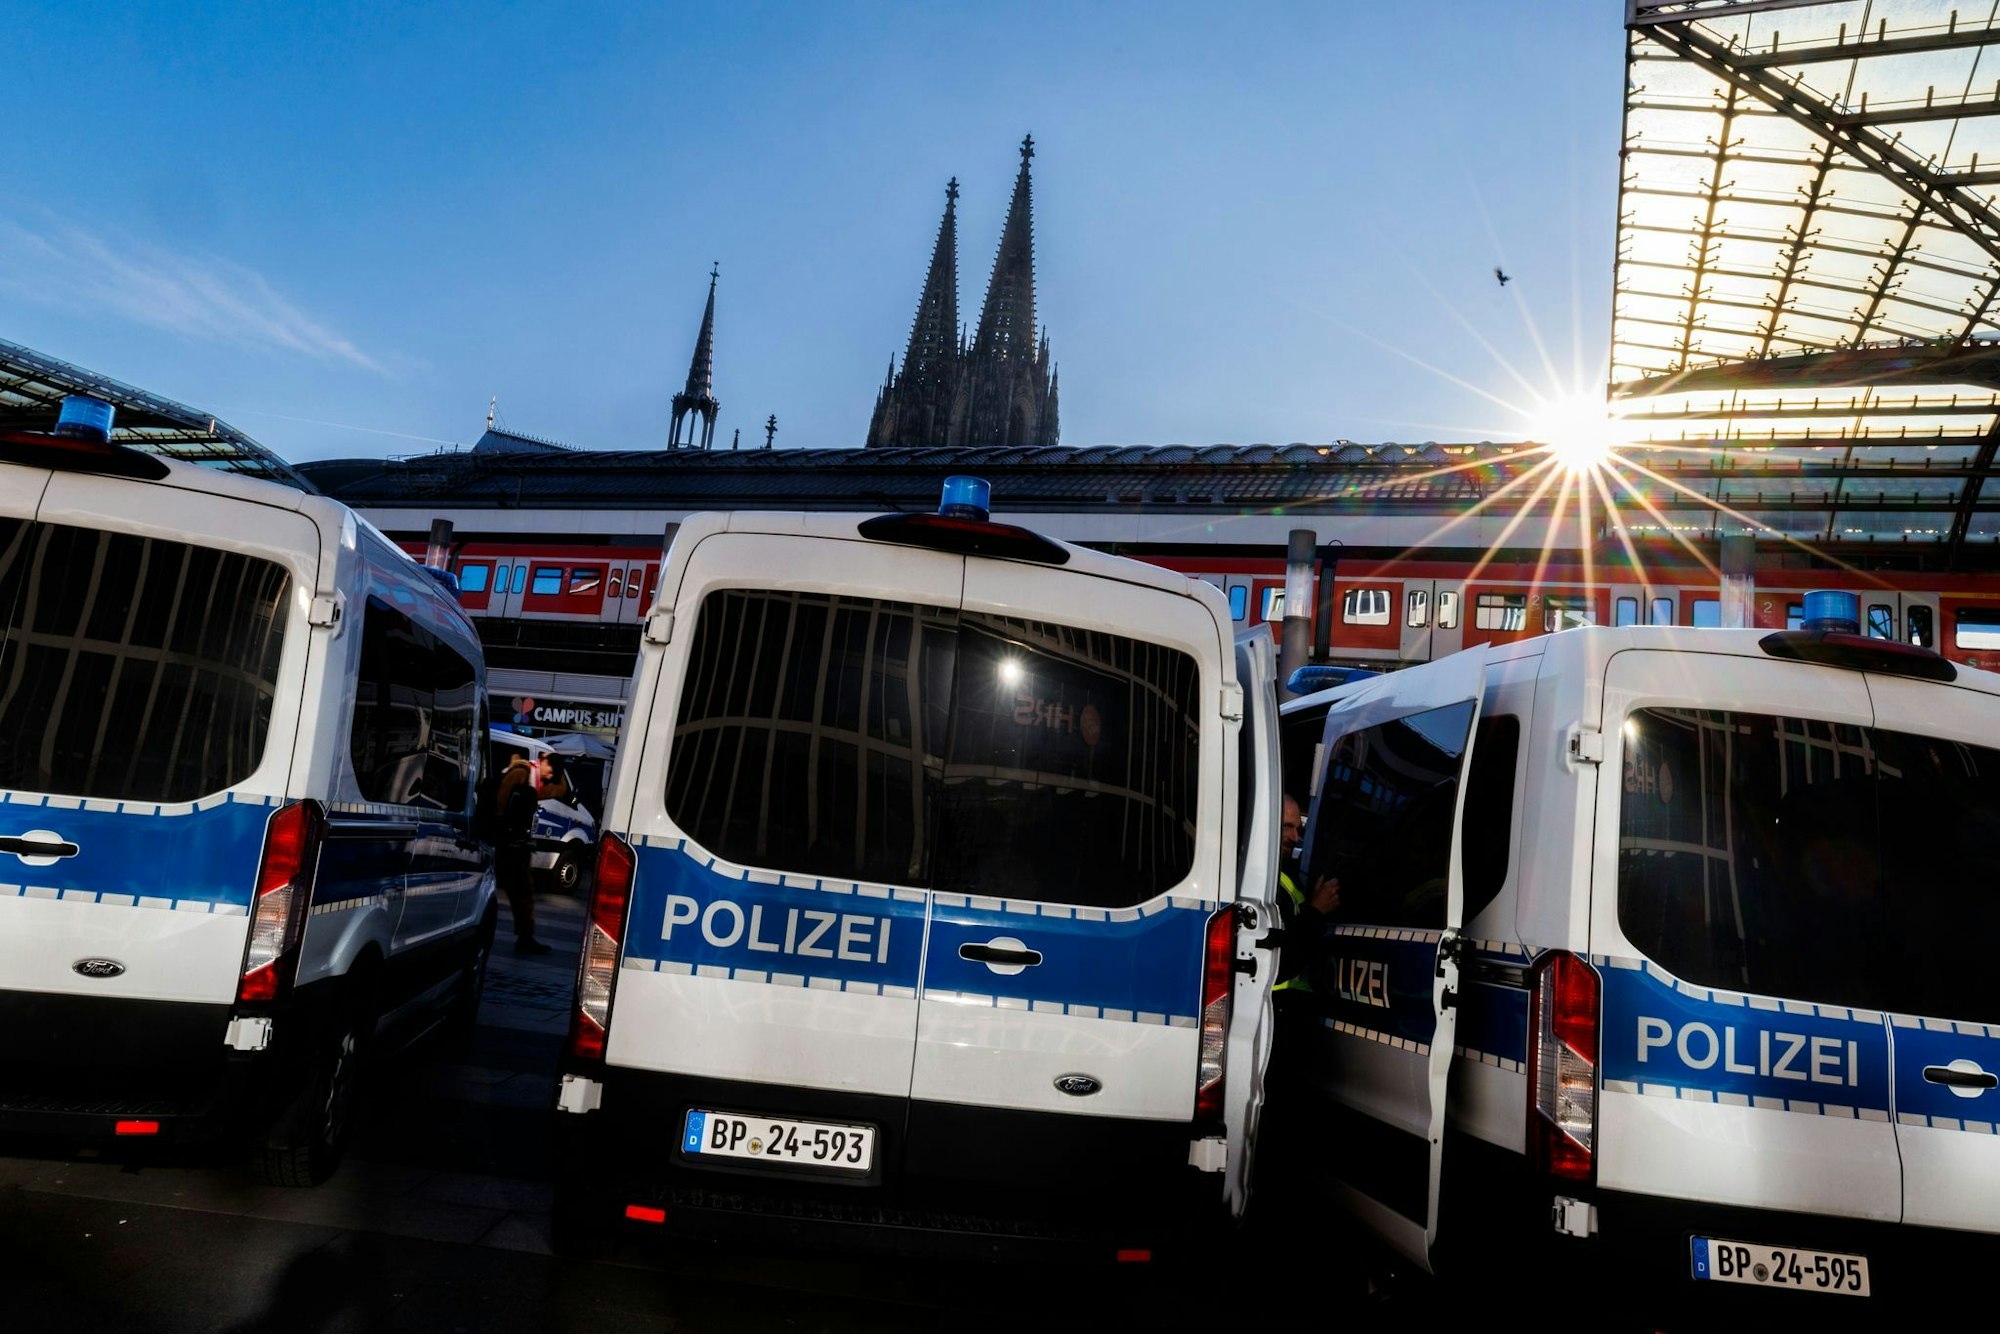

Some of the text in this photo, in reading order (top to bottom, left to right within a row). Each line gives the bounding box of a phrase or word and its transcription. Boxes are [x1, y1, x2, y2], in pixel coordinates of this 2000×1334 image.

[1763, 601, 1772, 613] 2
[533, 706, 593, 727] CAMPUS
[660, 894, 892, 965] POLIZEI
[82, 960, 114, 975] Ford
[1637, 1015, 1858, 1087] POLIZEI
[1064, 1078, 1093, 1091] Ford
[689, 1118, 865, 1163] D BP 24-593
[1697, 1244, 1862, 1291] D BP 24-595
